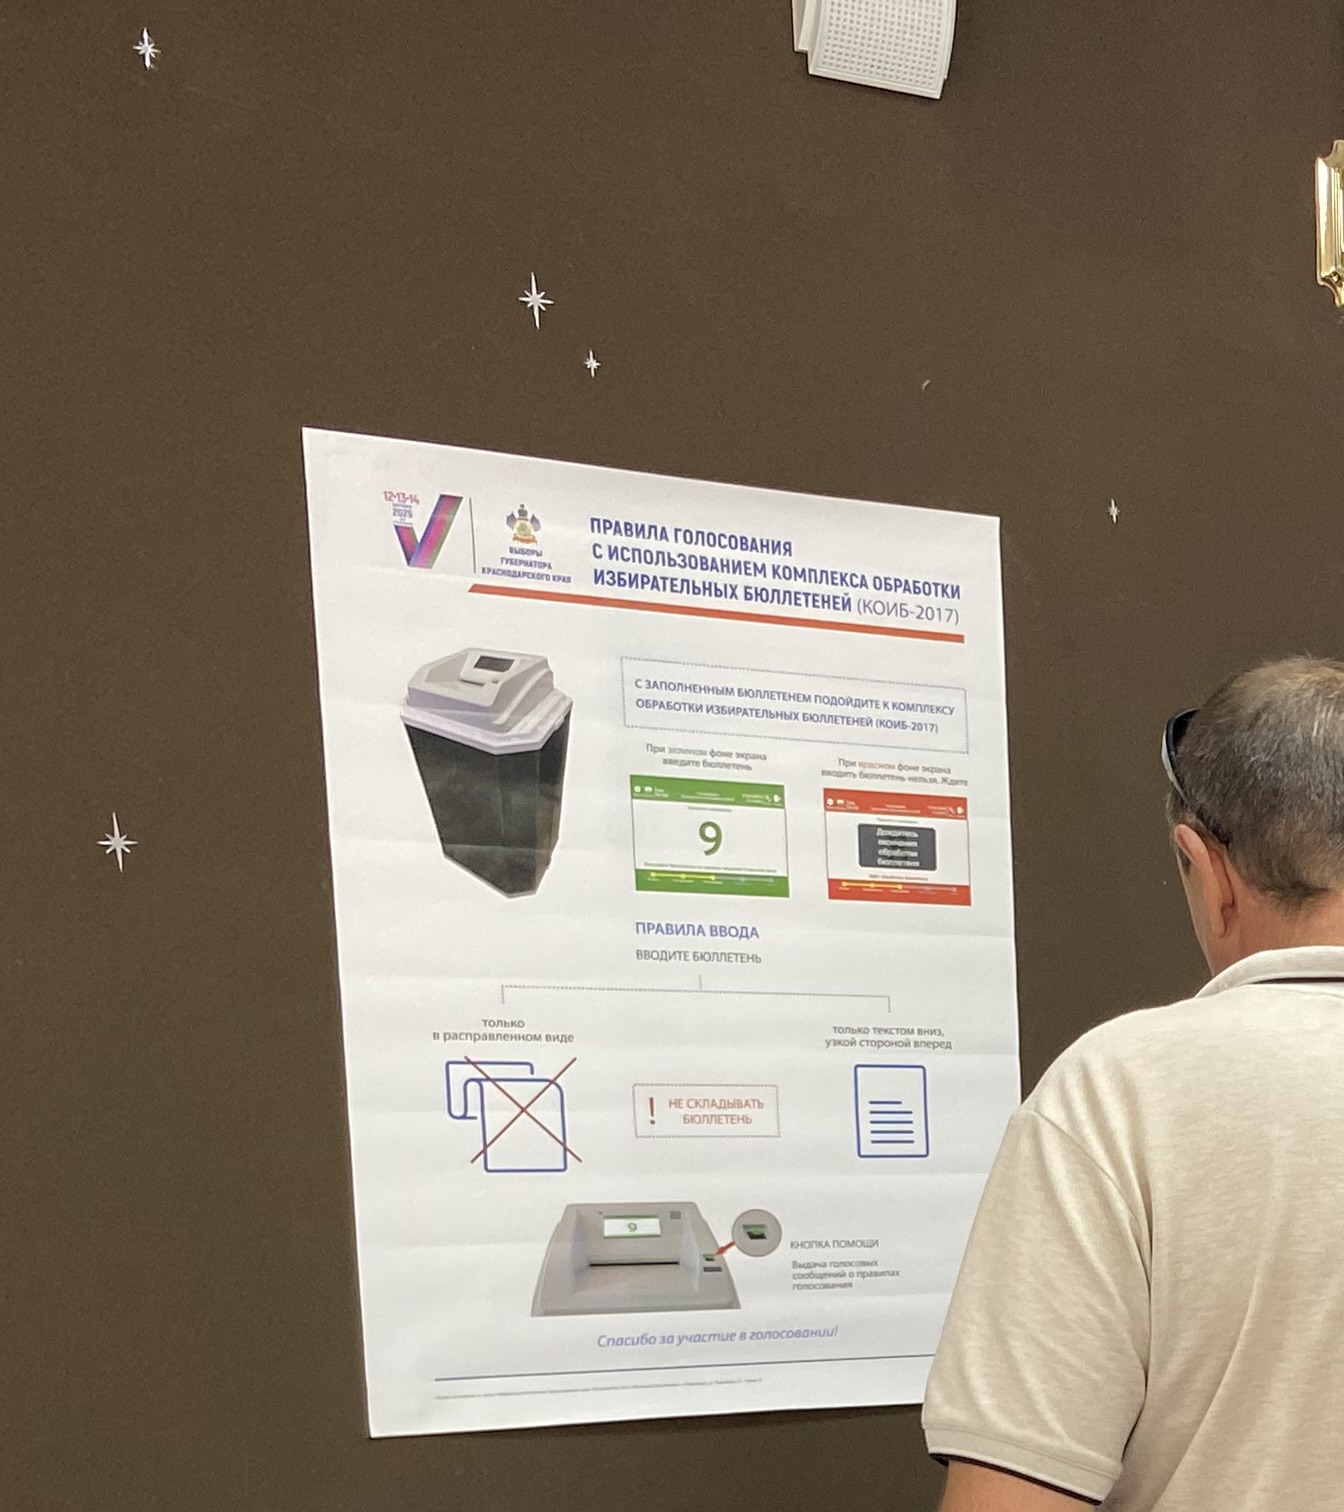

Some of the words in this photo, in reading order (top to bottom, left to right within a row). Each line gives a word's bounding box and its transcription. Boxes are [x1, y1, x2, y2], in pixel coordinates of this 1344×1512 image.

[590, 517, 670, 542] ПРАВИЛА
[674, 527, 793, 557] ГОЛОСОВАНИЯ
[508, 546, 543, 557] ВЫБОРЫ
[500, 557, 552, 570] ГУБЕРНАТОРА
[481, 566, 551, 582] КРАСНОДАРСКОГО
[552, 571, 572, 584] КРАЯ
[592, 543, 604, 560] С
[608, 545, 767, 579] ИСПОЛЬЗОВАНИЕМ
[772, 563, 869, 590] КОМПЛЕКСА
[872, 576, 961, 600] ОБРАБОТКИ
[593, 568, 739, 601] ИЗБИРАТЕЛЬНЫХ
[743, 586, 852, 612] БЮЛЛЕТЕНЕЙ
[857, 598, 960, 625] (КОИБ-2017)
[634, 678, 643, 690] С
[645, 679, 735, 697] ЗАПОЛНЕННЫМ
[737, 687, 812, 704] БЮЛЛЕТЕНЕМ
[814, 693, 881, 710] ПОДОЙДИТЕ
[883, 699, 890, 711] К
[892, 700, 955, 716] КОМПЛЕКСУ
[635, 698, 703, 714] ОБРАБОТКИ
[705, 704, 800, 722] ИЗБИРАТЕЛЬНЫХ
[802, 711, 874, 728] БЮЛЛЕТЕНЕЙ
[876, 718, 938, 734] (КОИБ-2017)
[646, 743, 665, 755] При
[709, 748, 733, 760] фоне
[735, 751, 767, 762] экрана
[662, 757, 700, 769] введите
[702, 759, 752, 772] бюллетень
[838, 758, 857, 770] При
[858, 760, 896, 771] красном
[897, 762, 920, 774] фоне
[921, 766, 951, 776] экрана
[821, 769, 857, 780] вводить
[859, 771, 906, 783] бюллетень
[940, 777, 968, 788] Ждите
[699, 821, 723, 857] 9
[635, 922, 706, 937] ПРАВИЛА
[710, 925, 760, 940] ВВОДА
[636, 949, 690, 962] ВВОДИТЕ
[692, 951, 762, 964] БЮЛЛЕТЕНЬ
[482, 1018, 525, 1029] только
[432, 1031, 440, 1041] в
[443, 1031, 542, 1043] расправленном
[545, 1033, 575, 1044] виде
[833, 1026, 870, 1035] только
[872, 1026, 915, 1036] текстом
[916, 1027, 945, 1038] вниз,
[825, 1038, 857, 1049] узкой
[859, 1038, 911, 1050] стороной
[913, 1039, 953, 1051] вперед
[668, 1098, 683, 1109] НЕ
[686, 1098, 764, 1111] СКЛАДЫВАТЬ
[683, 1114, 753, 1125] БЮЛЛЕТЕНЬ
[790, 1240, 830, 1250] КНОПКА
[832, 1239, 880, 1249] ПОМОЩИ
[791, 1260, 828, 1270] Выдача
[829, 1259, 878, 1268] голосовых
[792, 1270, 846, 1280] сообщений
[856, 1269, 900, 1279] правилах
[792, 1281, 853, 1290] голосования
[597, 1331, 657, 1348] Спасибо
[659, 1333, 674, 1346] за
[676, 1331, 737, 1346] участие
[739, 1331, 747, 1341] в
[750, 1325, 839, 1341] голосовании!
